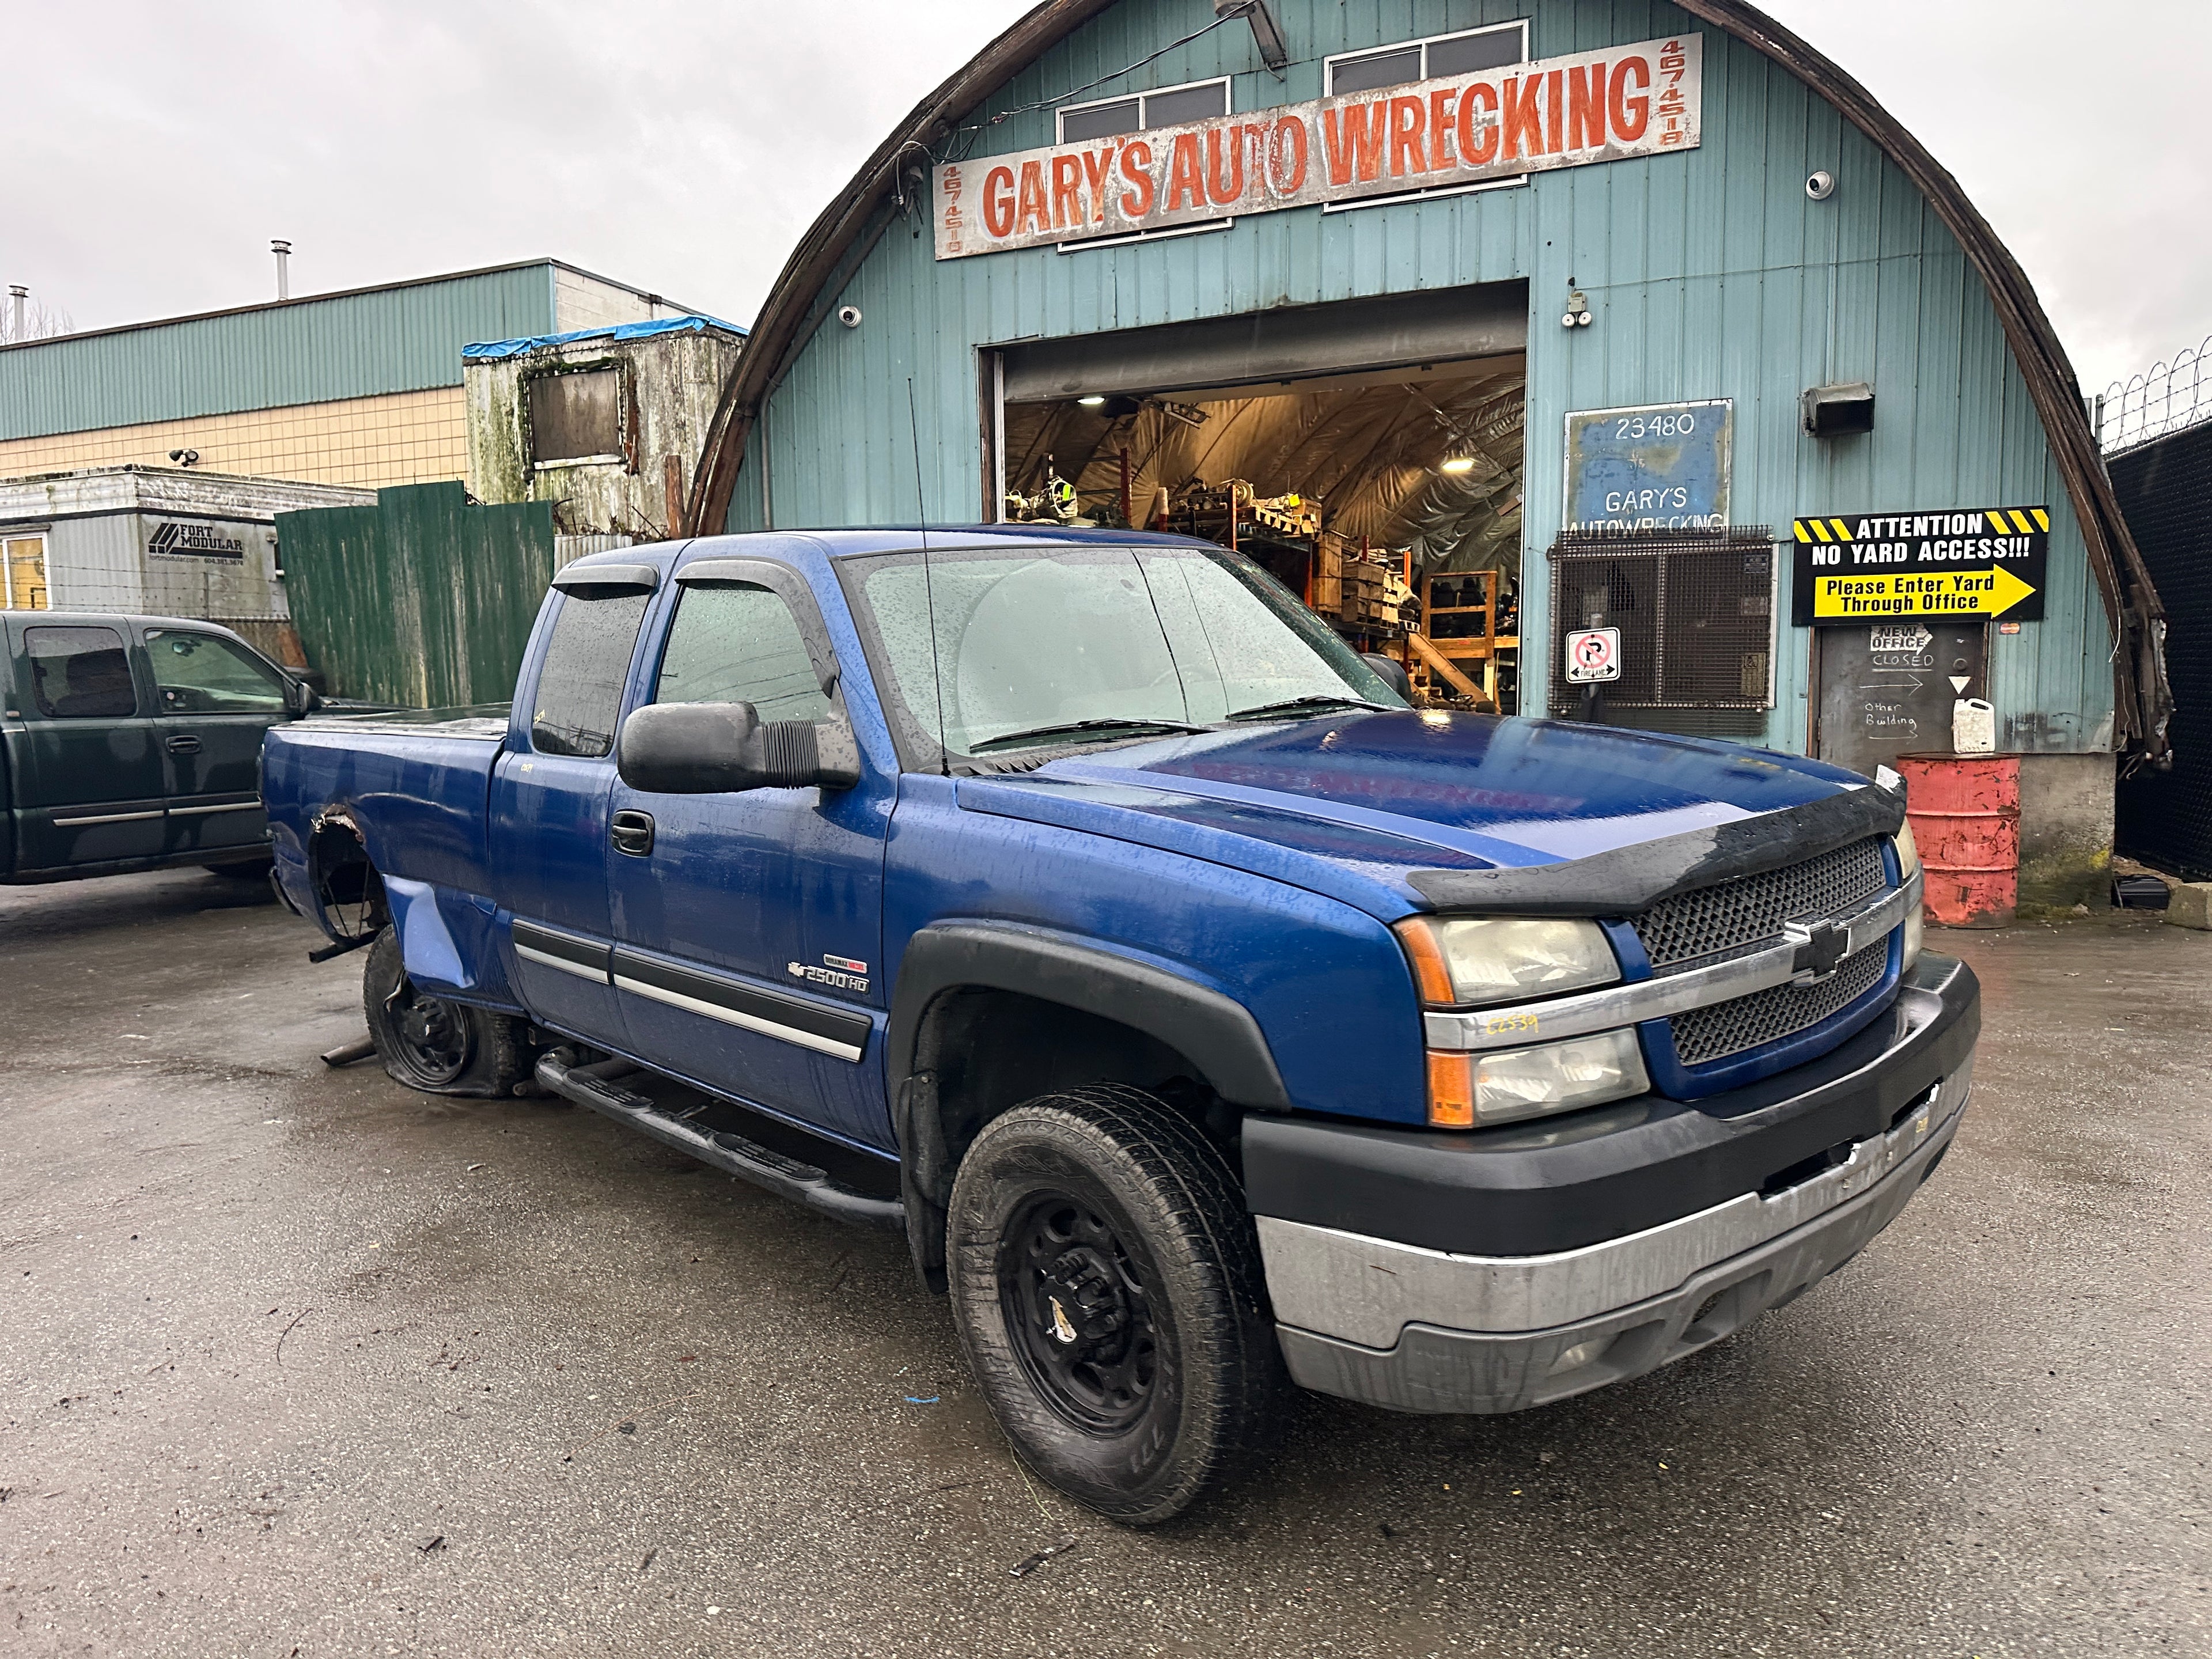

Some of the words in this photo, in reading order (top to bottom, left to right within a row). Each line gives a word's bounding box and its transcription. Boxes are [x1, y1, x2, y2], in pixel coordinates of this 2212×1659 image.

[981, 137, 1152, 238] GARY'S
[1164, 115, 1308, 211] AUTO
[1321, 55, 1650, 187] WRECKING
[1615, 413, 1695, 440] 23480
[1605, 487, 1687, 512] GARY'S
[180, 524, 213, 537] FORT
[1856, 513, 1983, 539] ATTENTION
[181, 536, 243, 550] MODULAR
[1812, 545, 1841, 566] NO
[1850, 542, 1908, 564] YARD
[1917, 536, 2030, 562] ACCESS!!!
[149, 554, 199, 563] fortmodular.com
[1827, 579, 1885, 596] Please
[1894, 577, 1944, 593] Enter
[1952, 575, 1995, 592] Yard
[1840, 596, 1914, 613] Through
[1922, 594, 1979, 609] Office
[1878, 626, 1916, 637] NEW
[1872, 637, 1925, 649] OFFICE
[1873, 654, 1934, 666] CLOSED
[1865, 702, 1902, 712] Other
[1866, 714, 1917, 730] Building
[1486, 1014, 1539, 1035] C2539
